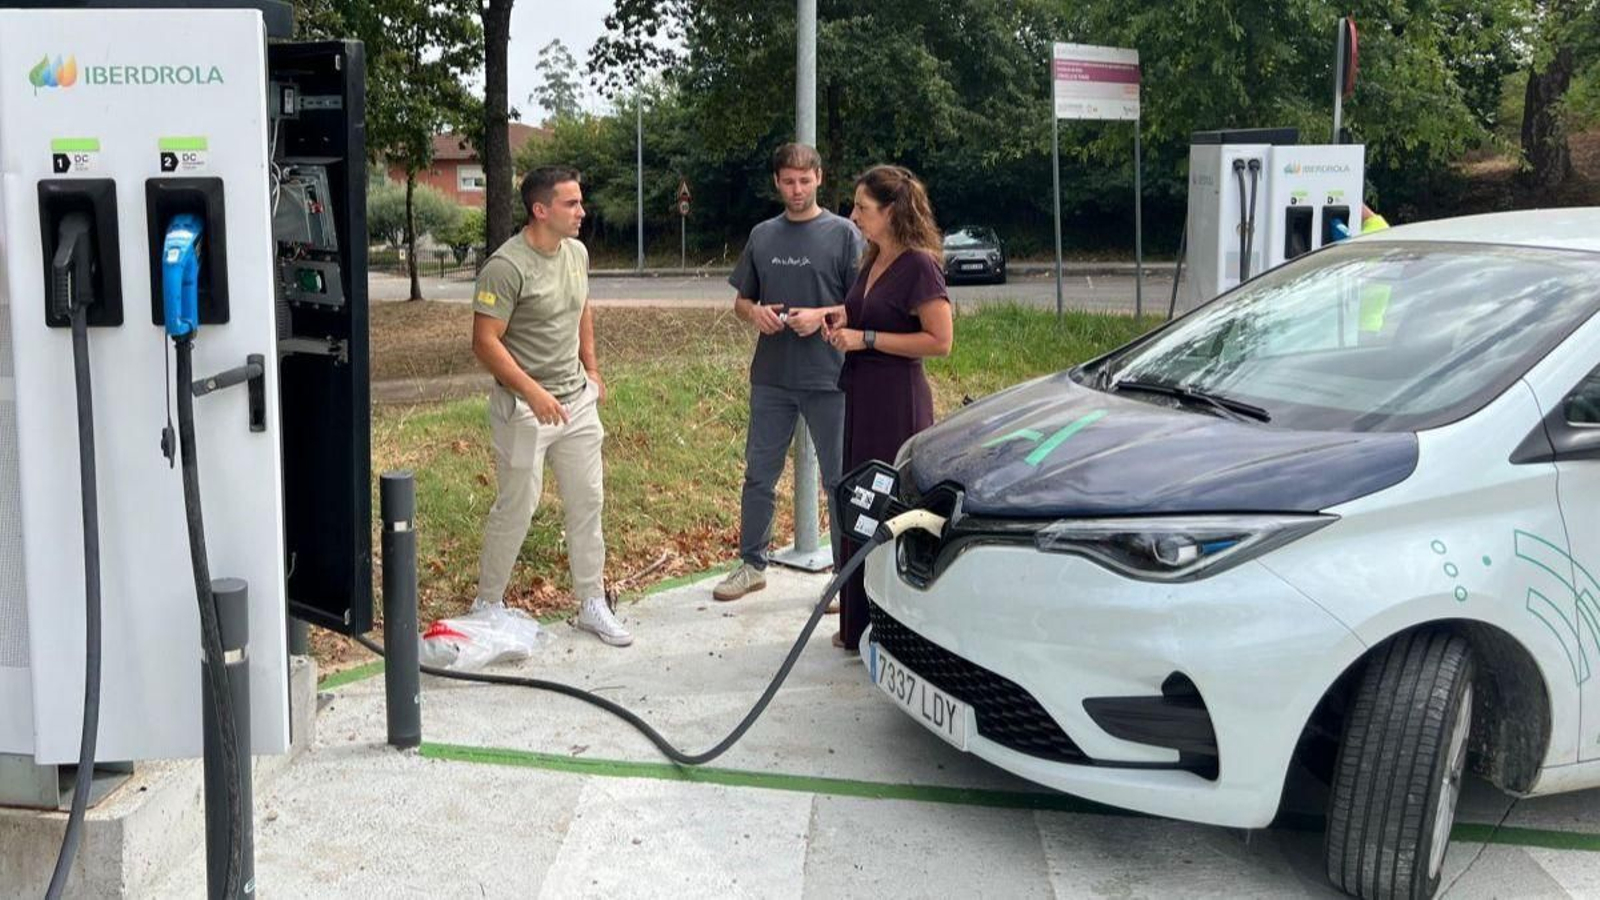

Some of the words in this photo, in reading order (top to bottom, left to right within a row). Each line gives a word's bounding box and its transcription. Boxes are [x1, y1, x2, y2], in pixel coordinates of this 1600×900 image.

[84, 65, 224, 85] IBERDROLA
[74, 155, 89, 163] DC
[164, 157, 172, 167] 2
[182, 153, 197, 161] DC
[56, 159, 63, 169] 1
[1303, 164, 1350, 173] IBERDROLA
[879, 654, 916, 705] 7337
[922, 684, 956, 735] LDY
